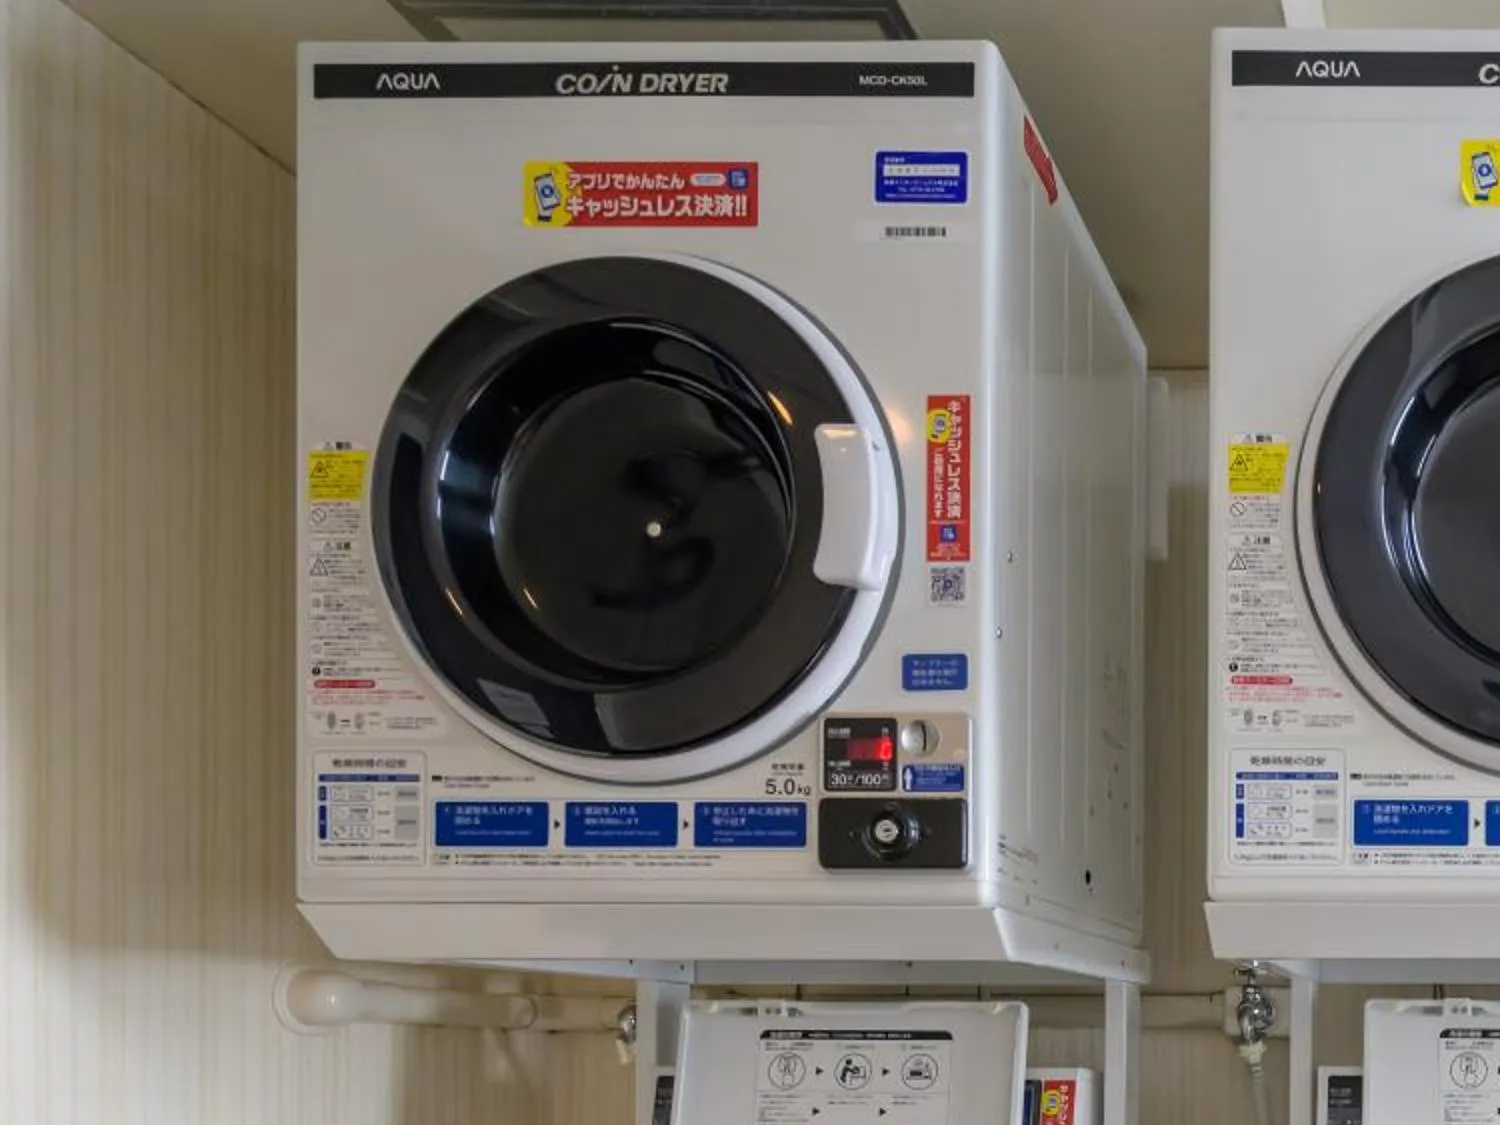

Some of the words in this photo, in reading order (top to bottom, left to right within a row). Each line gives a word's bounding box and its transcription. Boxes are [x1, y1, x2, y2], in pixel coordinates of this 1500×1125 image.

[1295, 60, 1361, 78] AQUA
[376, 71, 441, 91] AQUA
[555, 64, 632, 95] COIN
[638, 73, 729, 95] DRYER
[567, 173, 685, 190] アプリでかんたん
